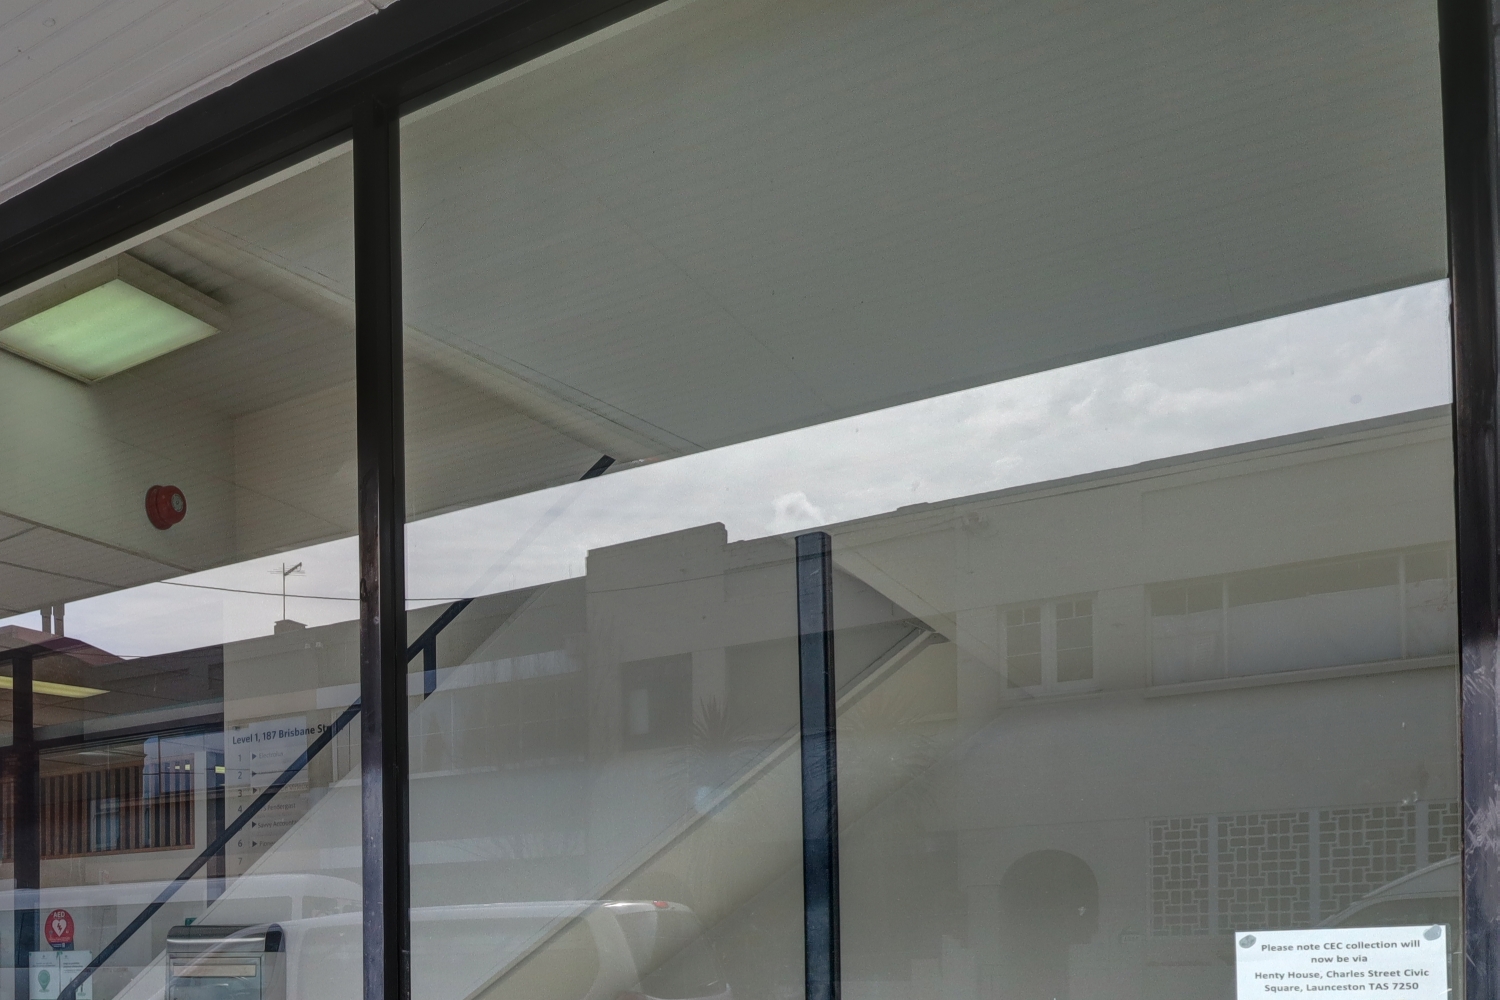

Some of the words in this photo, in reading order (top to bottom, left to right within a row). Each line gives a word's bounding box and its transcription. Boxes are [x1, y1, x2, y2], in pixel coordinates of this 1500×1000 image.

[232, 735, 253, 745] Level
[262, 731, 277, 741] 187
[278, 727, 316, 739] Brisbane
[1297, 943, 1320, 951] note
[1323, 942, 1343, 950] CEC
[1345, 941, 1398, 949] collection
[1400, 940, 1420, 948] will
[1311, 956, 1333, 964] now
[1336, 955, 1349, 963] be
[1352, 955, 1368, 963] via
[1254, 972, 1285, 981] Henty
[1287, 971, 1323, 980] House,
[1326, 970, 1365, 978] Charles
[1368, 969, 1401, 977] Street
[1404, 969, 1430, 977] Civic
[1264, 984, 1303, 993] Square,
[1306, 983, 1366, 991] Launceston
[1368, 982, 1389, 990] TAS
[1392, 982, 1419, 990] 7250
